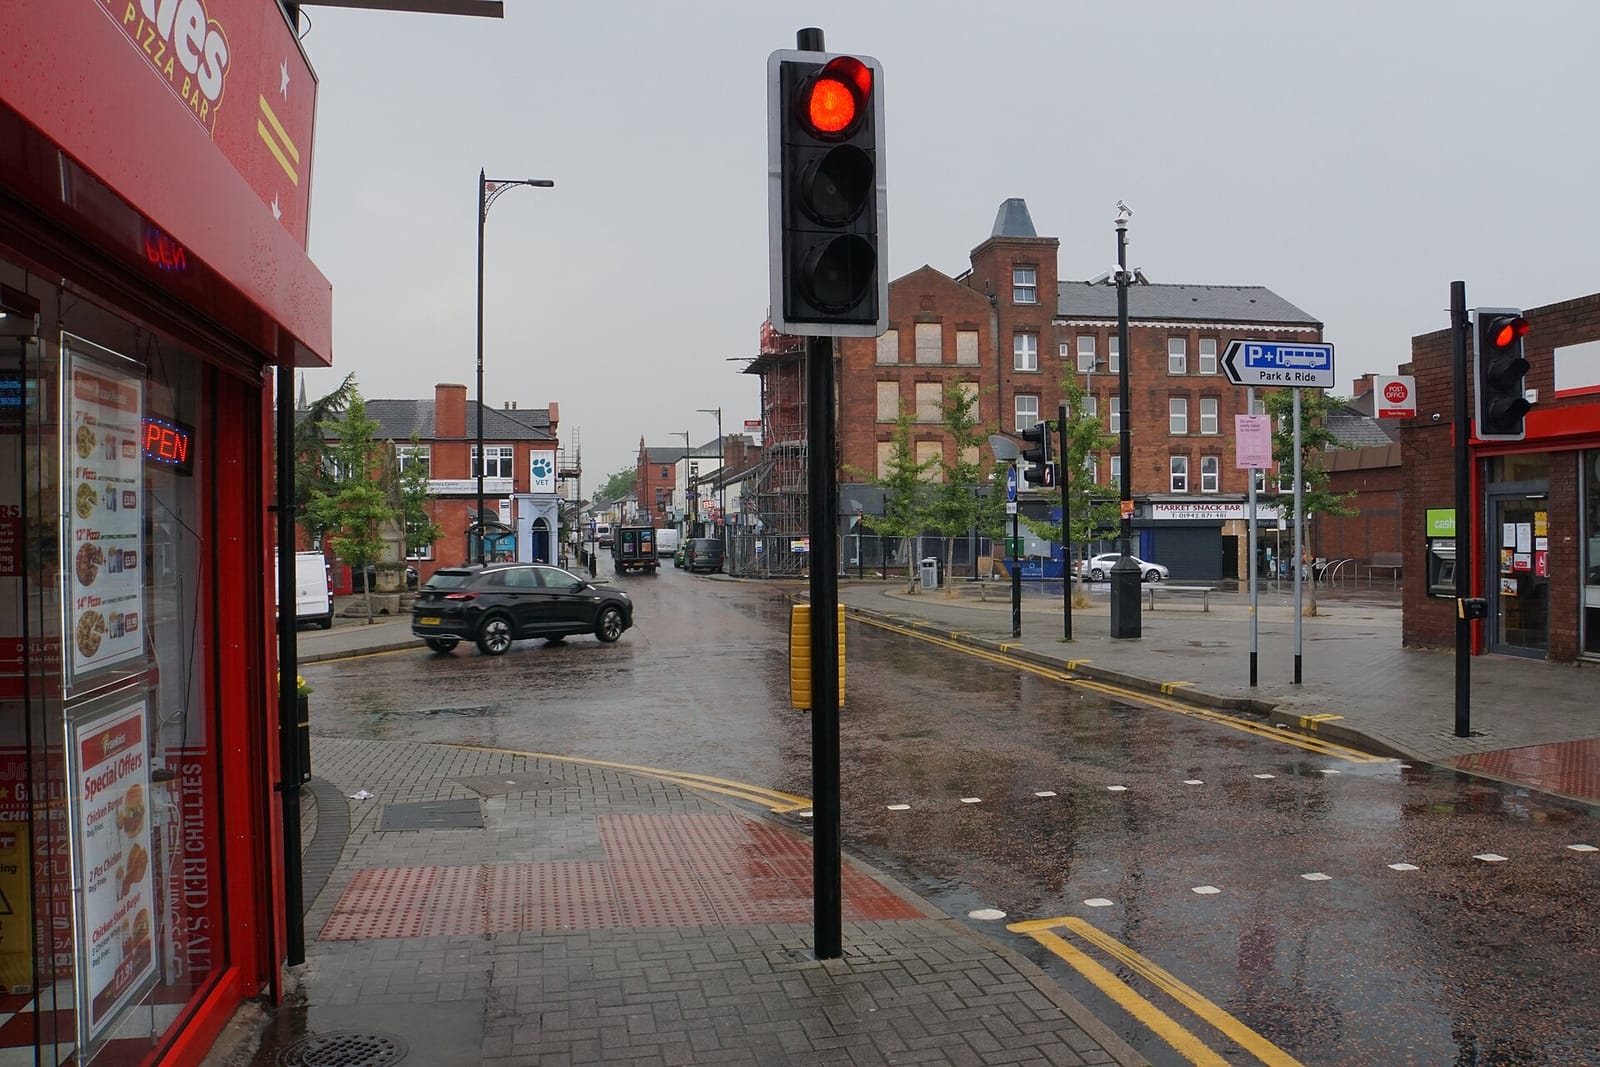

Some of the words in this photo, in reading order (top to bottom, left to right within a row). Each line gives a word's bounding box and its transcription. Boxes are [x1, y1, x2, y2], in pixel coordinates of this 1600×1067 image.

[124, 1, 174, 81] PIZZA
[182, 75, 209, 122] BAR
[1260, 371, 1282, 381] Park
[1284, 372, 1291, 381] &
[1295, 372, 1316, 382] Ride
[85, 761, 117, 802] Special
[118, 752, 142, 779] Offers
[87, 805, 108, 827] Chicken
[183, 763, 205, 853] CHILLIES
[104, 851, 122, 872] Chicken
[183, 858, 209, 908] RED
[92, 919, 113, 943] Chicken
[186, 914, 211, 972] SALT
